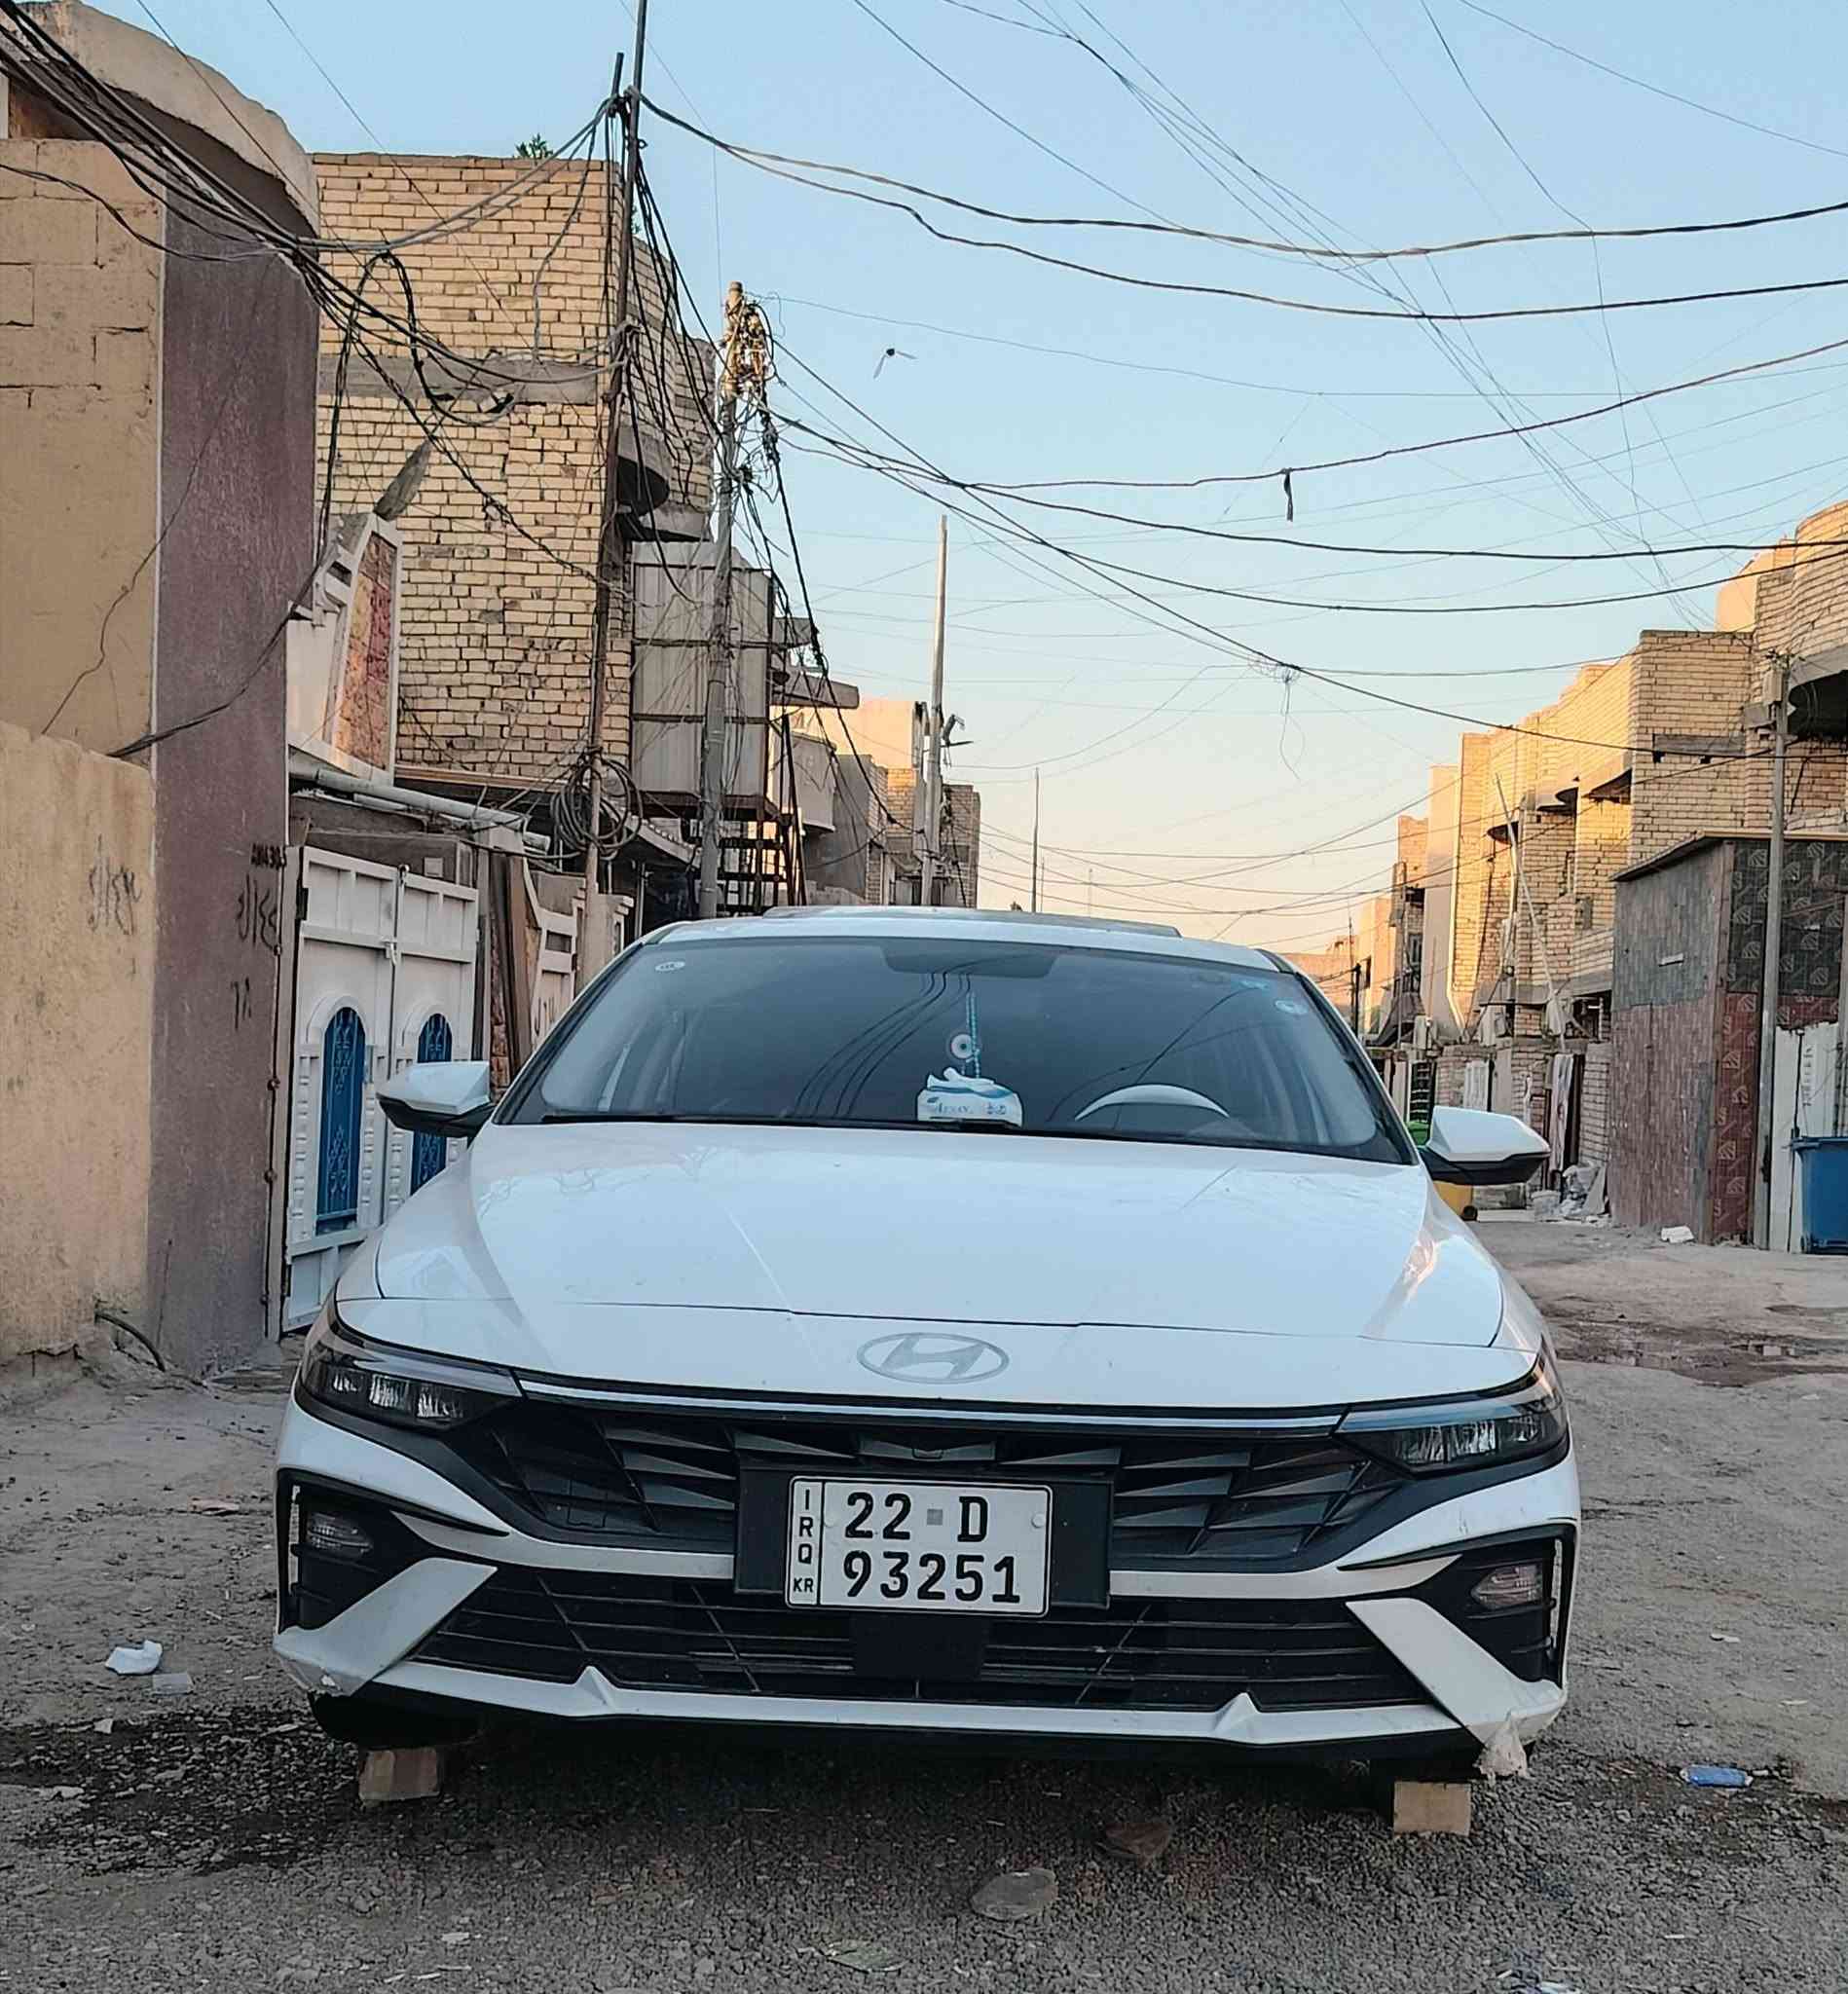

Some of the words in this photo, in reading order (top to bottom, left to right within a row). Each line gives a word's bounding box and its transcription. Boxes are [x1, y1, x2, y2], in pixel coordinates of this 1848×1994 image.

[798, 1489, 814, 1565] IRQ
[845, 1492, 911, 1540] 22
[957, 1496, 988, 1542] D
[793, 1577, 814, 1593] KR
[843, 1550, 1020, 1603] 93251
